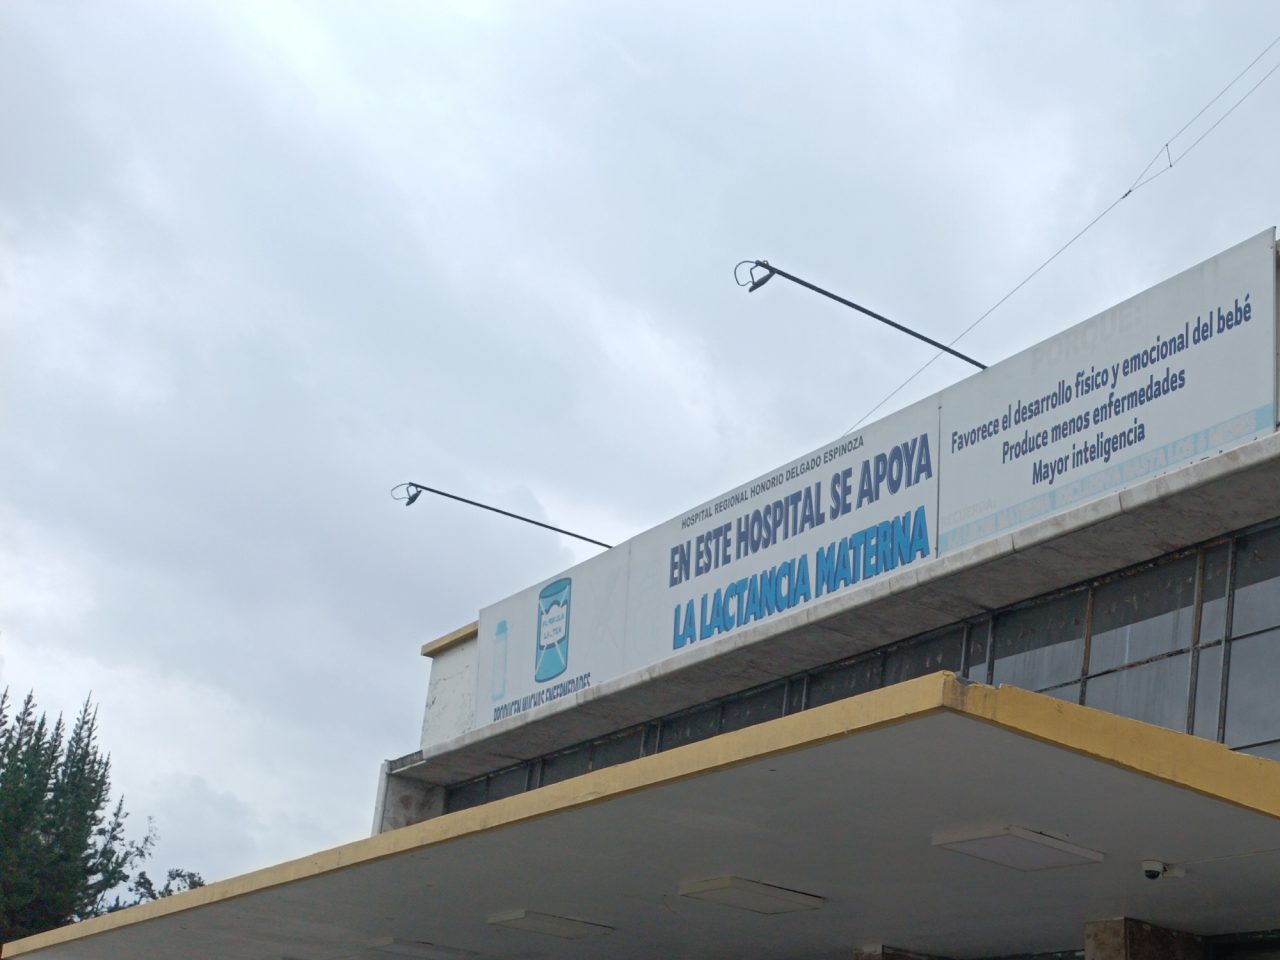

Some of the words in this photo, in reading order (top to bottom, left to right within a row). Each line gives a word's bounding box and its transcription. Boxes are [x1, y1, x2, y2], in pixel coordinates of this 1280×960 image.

[951, 418, 1000, 454] Favorece
[1002, 404, 1012, 432] el
[1014, 379, 1073, 426] desarrollo
[1074, 366, 1109, 399] físico
[1110, 362, 1120, 390] y
[1122, 321, 1190, 378] emocional
[1192, 310, 1214, 346] del
[1217, 292, 1252, 335] bebé
[1002, 430, 1049, 465] Produce
[1051, 410, 1090, 444] menos
[1092, 367, 1186, 426] enfermedades
[668, 540, 691, 588] EN
[694, 521, 732, 578] ESTE
[735, 481, 826, 560] HOSPITAL
[830, 467, 853, 521] SE
[856, 432, 933, 511] APOYA
[682, 509, 713, 530] HOSPITAL
[714, 490, 749, 515] REGIONAL
[750, 472, 784, 498] HONORIO
[785, 455, 822, 481] DELGADO
[824, 435, 864, 465] ESPINOZA
[1032, 453, 1070, 486] Mayor
[1071, 417, 1146, 470] inteligencia
[673, 598, 697, 650] LA
[700, 553, 812, 641] LACTANCIA
[815, 505, 931, 599] MATERNA
